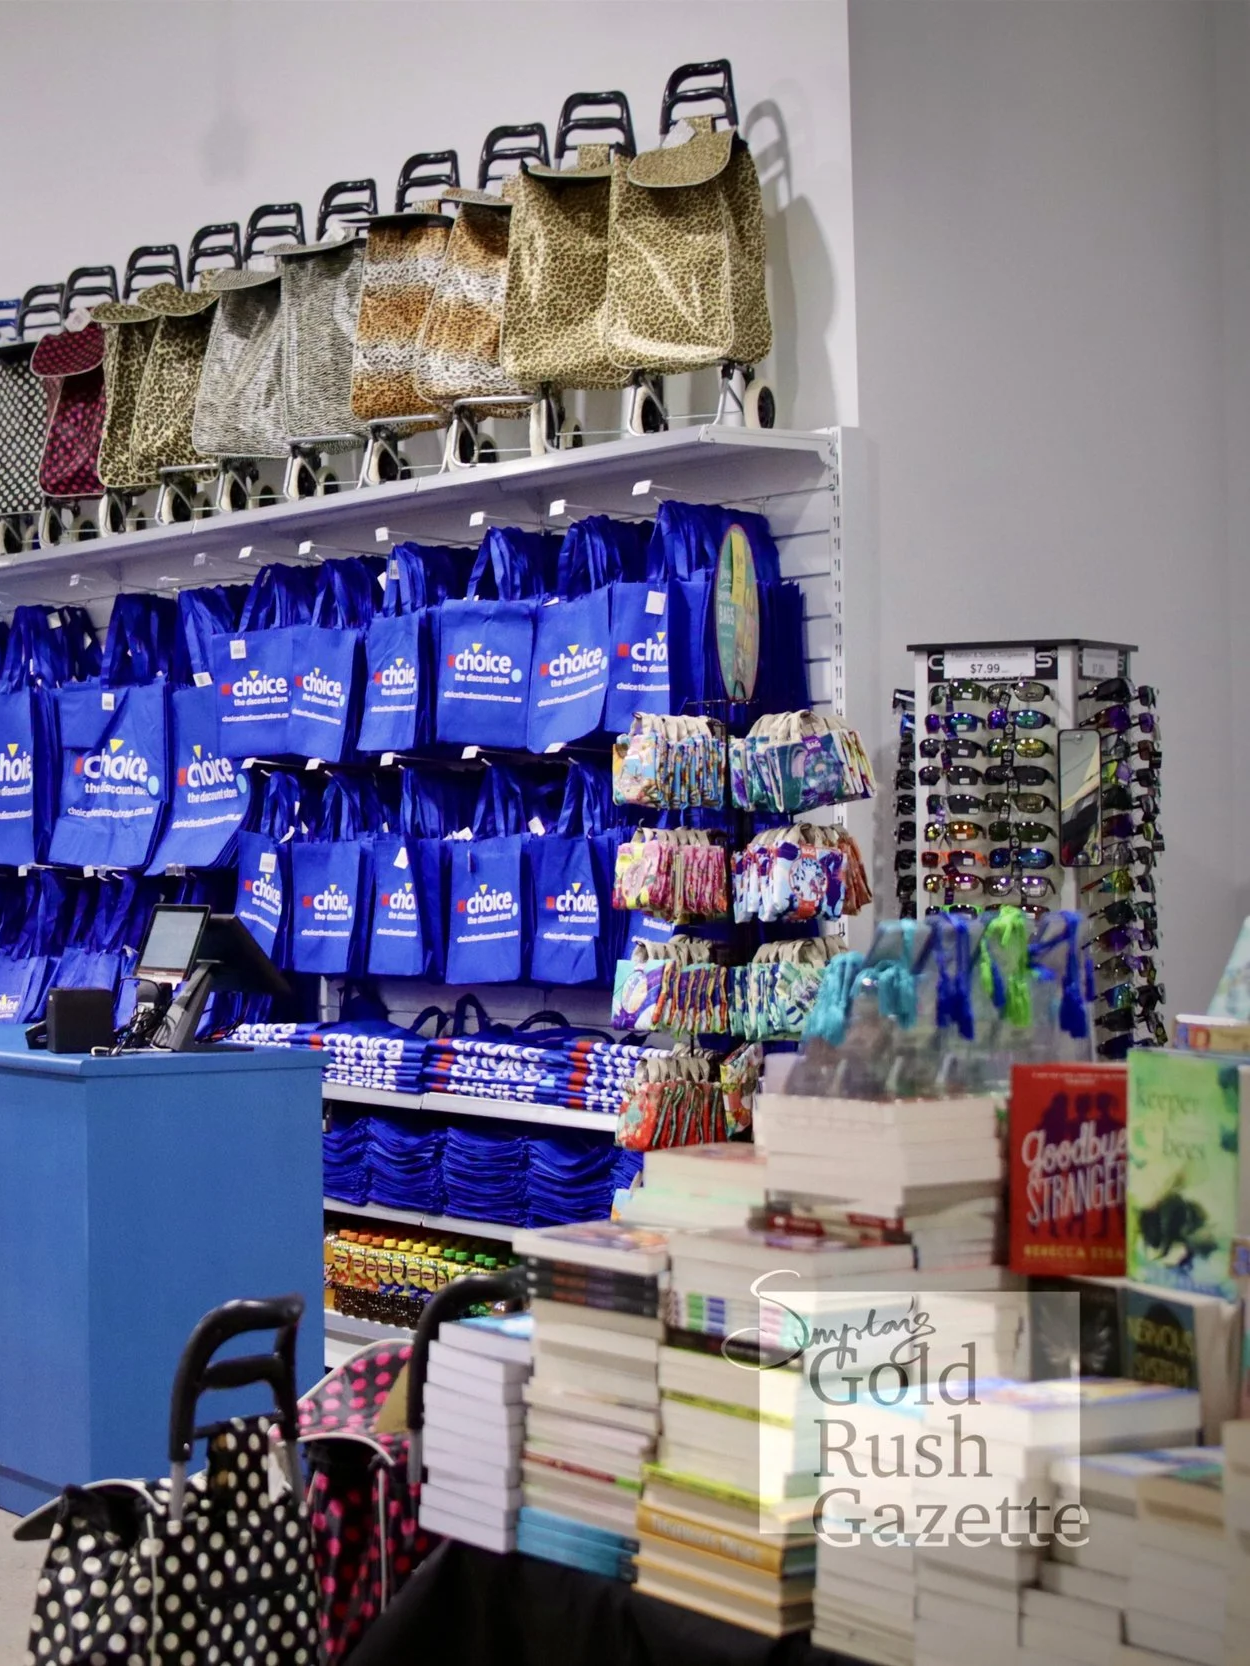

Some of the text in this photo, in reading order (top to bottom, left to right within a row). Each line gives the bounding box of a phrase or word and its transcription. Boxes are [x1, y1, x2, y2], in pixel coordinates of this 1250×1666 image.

[455, 650, 511, 673] choice
[549, 647, 602, 676] choice
[232, 675, 287, 697] choice
[302, 669, 342, 697] choice
[84, 748, 148, 782] choice
[187, 753, 235, 787] choice
[467, 889, 512, 914] choice
